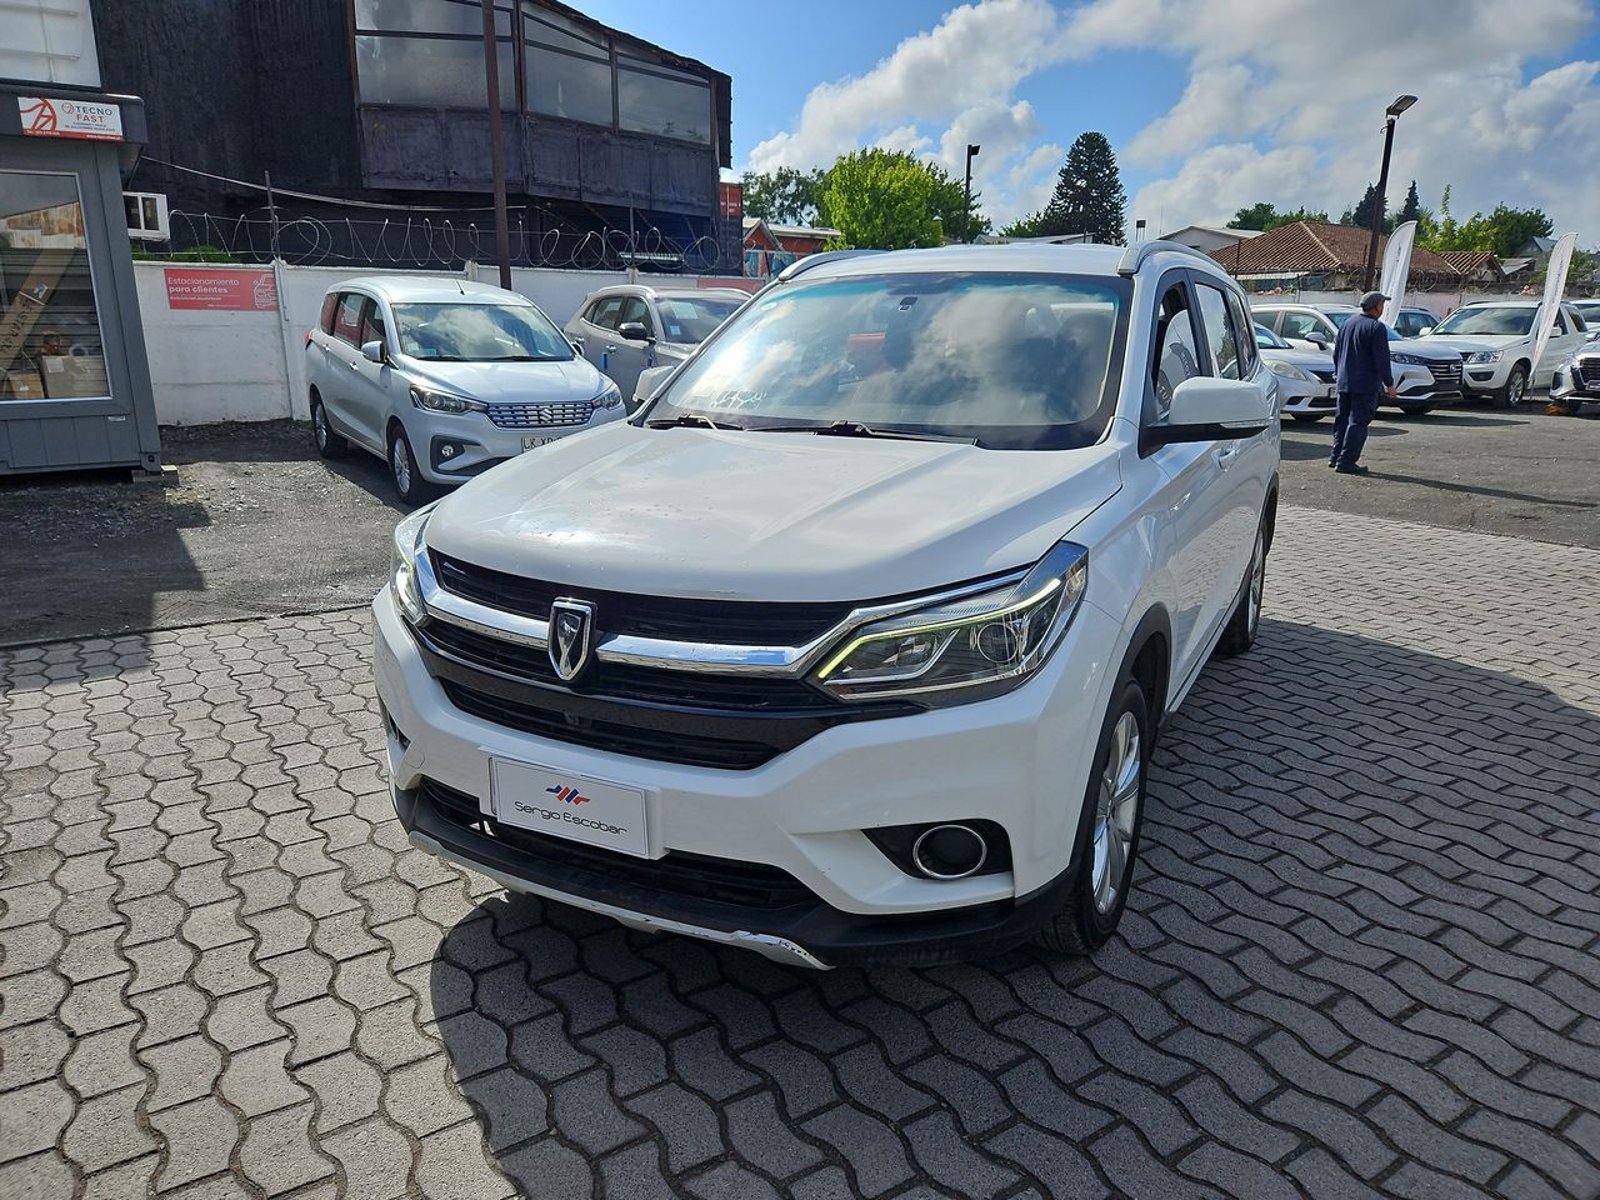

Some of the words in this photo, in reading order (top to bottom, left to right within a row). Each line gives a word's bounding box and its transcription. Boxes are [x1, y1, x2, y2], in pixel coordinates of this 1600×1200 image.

[75, 105, 113, 116] TECNO
[76, 114, 105, 123] FAST
[167, 276, 240, 286] Estacionamiento
[169, 286, 191, 294] para
[192, 285, 229, 294] clientes
[563, 812, 628, 834] Escobar
